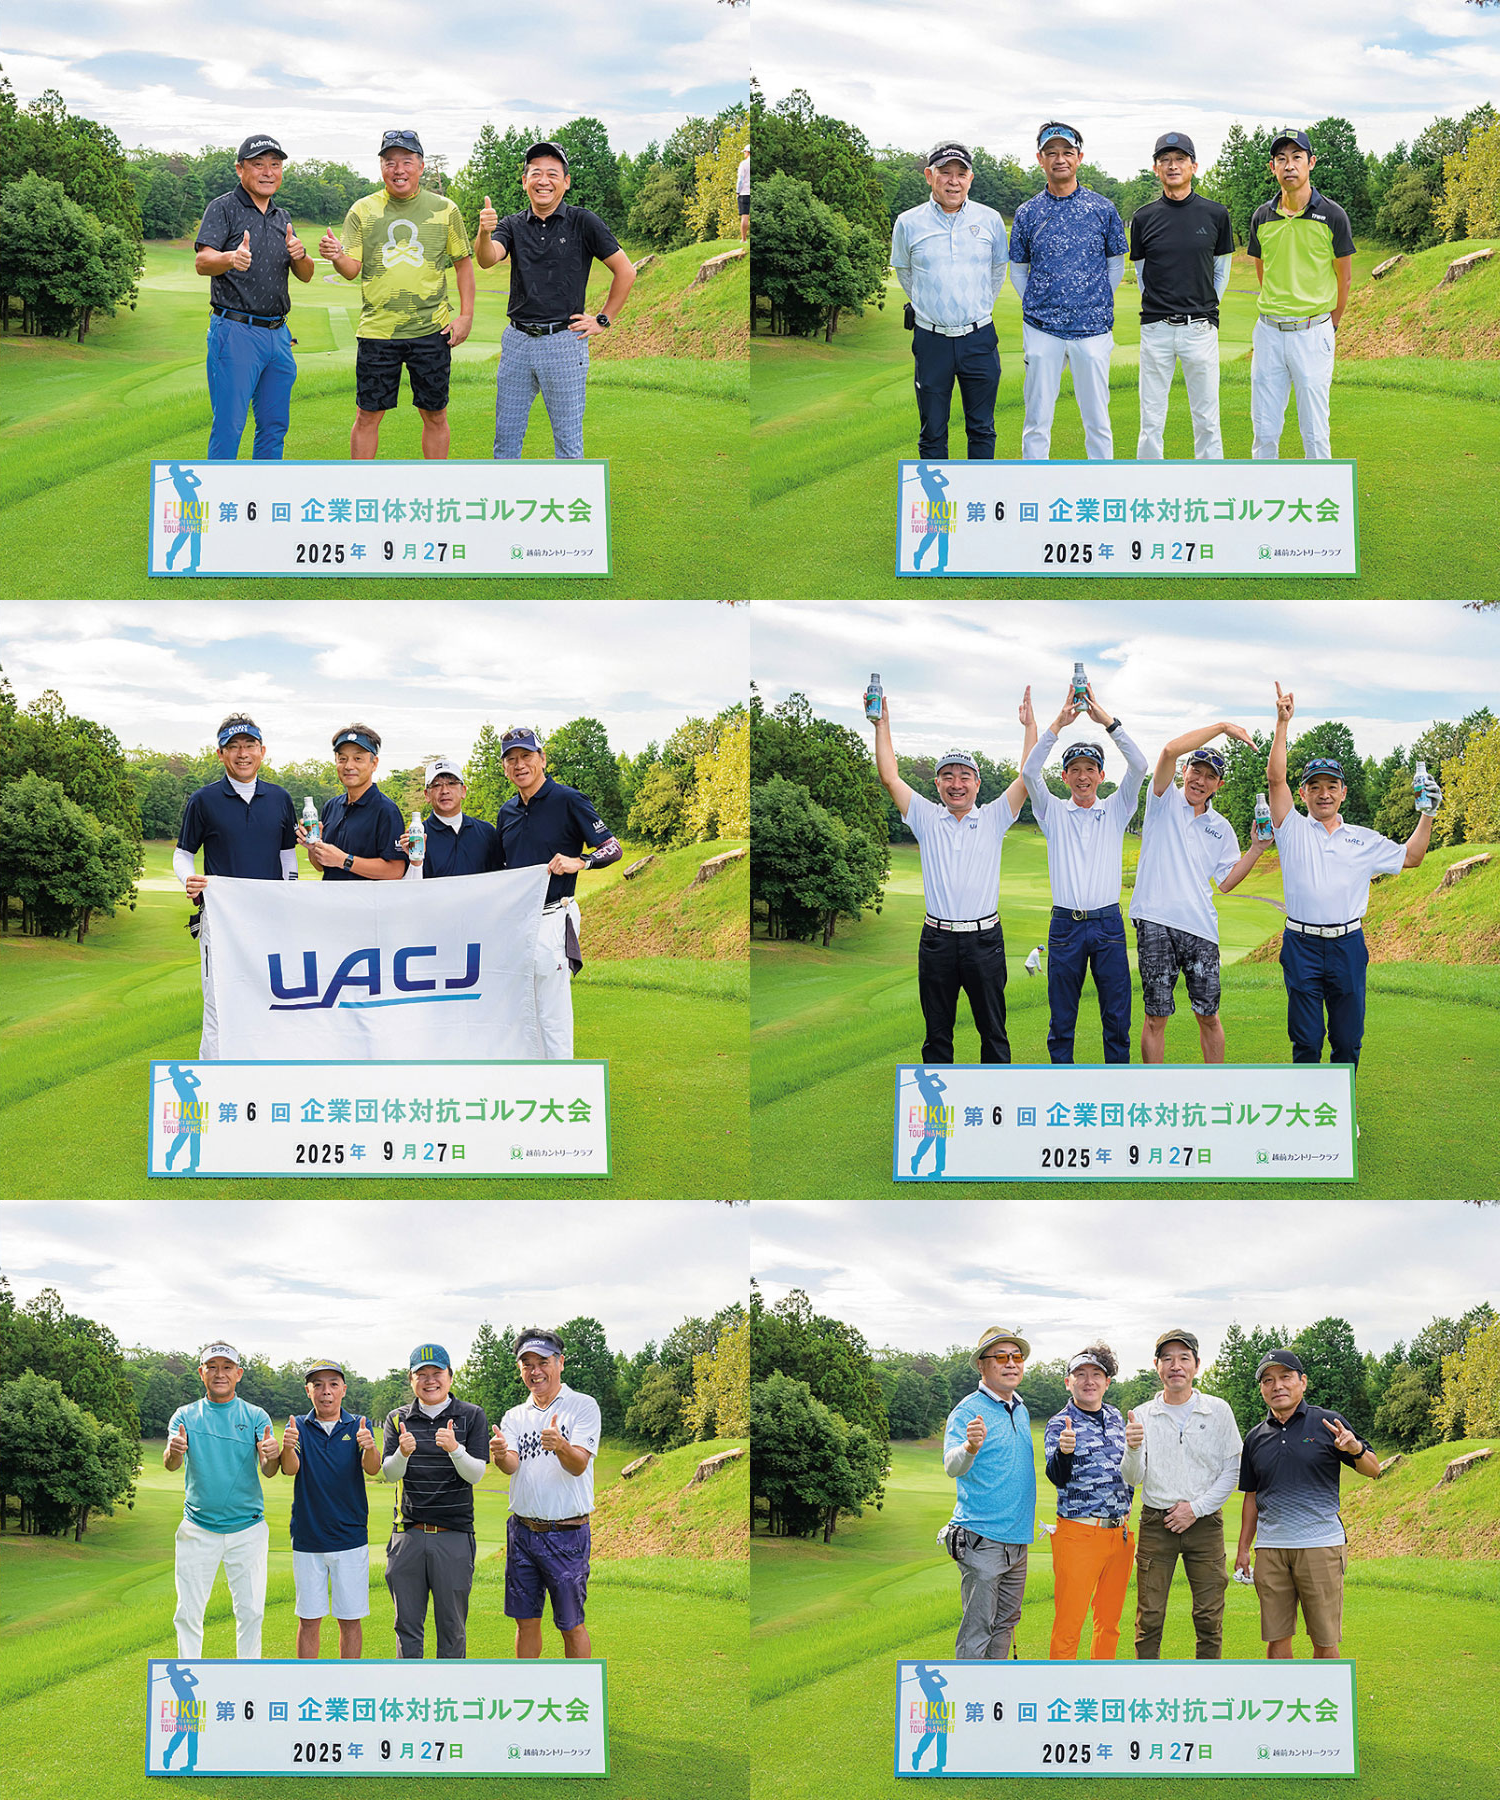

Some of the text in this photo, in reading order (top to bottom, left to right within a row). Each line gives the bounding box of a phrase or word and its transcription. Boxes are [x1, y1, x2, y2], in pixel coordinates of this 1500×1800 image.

[164, 501, 209, 519] FUKUI
[912, 501, 957, 519] FUKUI
[164, 525, 209, 533] TOURNAMENT
[911, 525, 957, 533] TOURNAMENT
[526, 549, 593, 557] 越前カントリークラブ
[1274, 549, 1341, 557] 越前カントリークラブ
[268, 942, 481, 1010] UACJ
[163, 1102, 209, 1119] FUKUI
[909, 1105, 954, 1123] FUKUI
[163, 1125, 208, 1134] TOURNAMENT
[909, 1129, 954, 1138] TOURNAMENT
[526, 1149, 593, 1157] 越前カントリークラブ
[1272, 1153, 1339, 1161] 越前カントリークラブ
[161, 1700, 206, 1718] FUKUI
[910, 1701, 955, 1719] FUKUI
[161, 1724, 206, 1732] TOURNAMENT
[910, 1725, 955, 1734] TOURNAMENT
[523, 1748, 590, 1757] 越前カントリークラブ
[1273, 1749, 1340, 1757] 越前カントリークラブ
